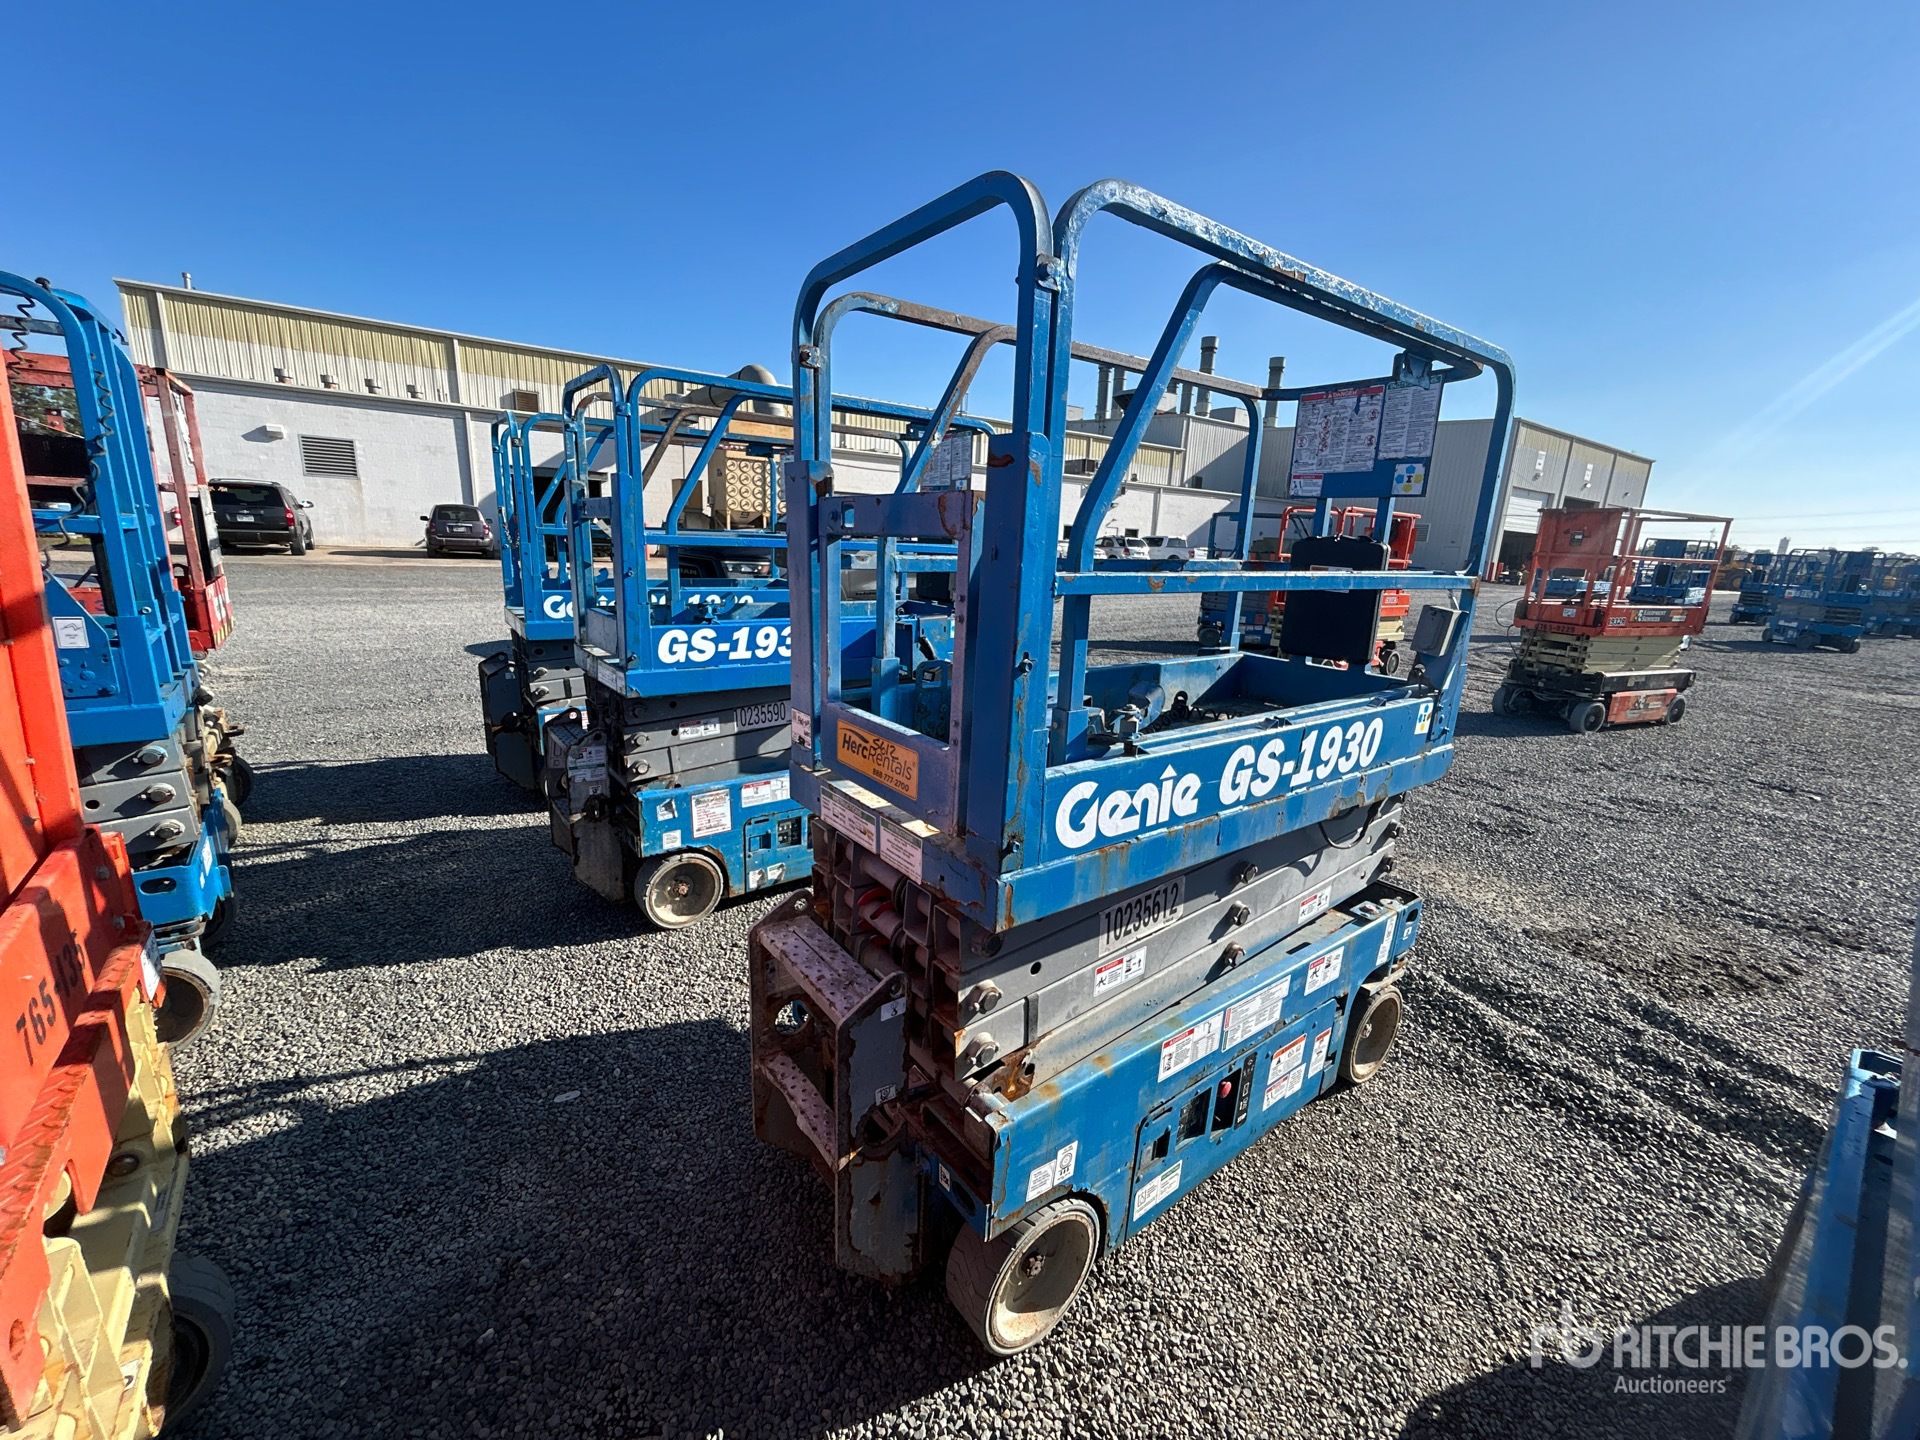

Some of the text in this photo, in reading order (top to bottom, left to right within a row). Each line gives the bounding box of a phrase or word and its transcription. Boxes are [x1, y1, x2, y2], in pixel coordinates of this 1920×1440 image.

[734, 702, 786, 728] 10235590
[872, 768, 910, 792] 888-777-2700
[1055, 717, 1384, 849] Genie GS-1930
[1104, 882, 1179, 945] 10235612
